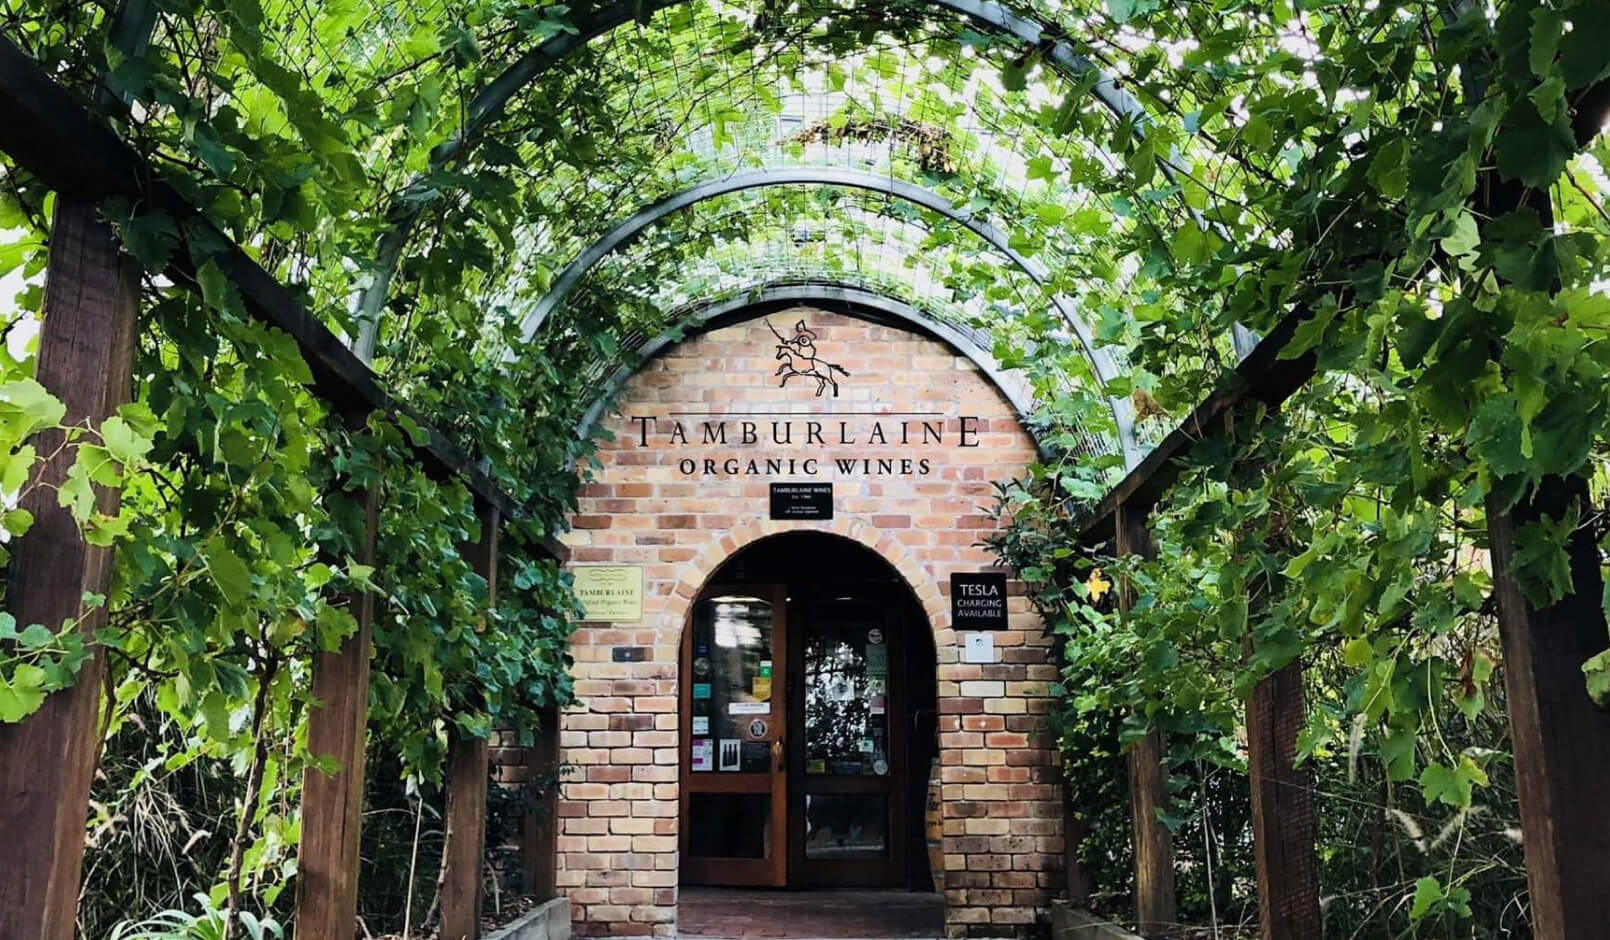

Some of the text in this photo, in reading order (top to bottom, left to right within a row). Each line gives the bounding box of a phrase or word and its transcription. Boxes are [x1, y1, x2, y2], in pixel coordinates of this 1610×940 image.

[631, 416, 980, 447] TAMBURLAINE
[680, 459, 930, 474] ORGANIC WINES
[959, 584, 999, 596] TESLA
[957, 599, 1002, 608] CHARGING
[957, 609, 1002, 618] AVAILABLE
